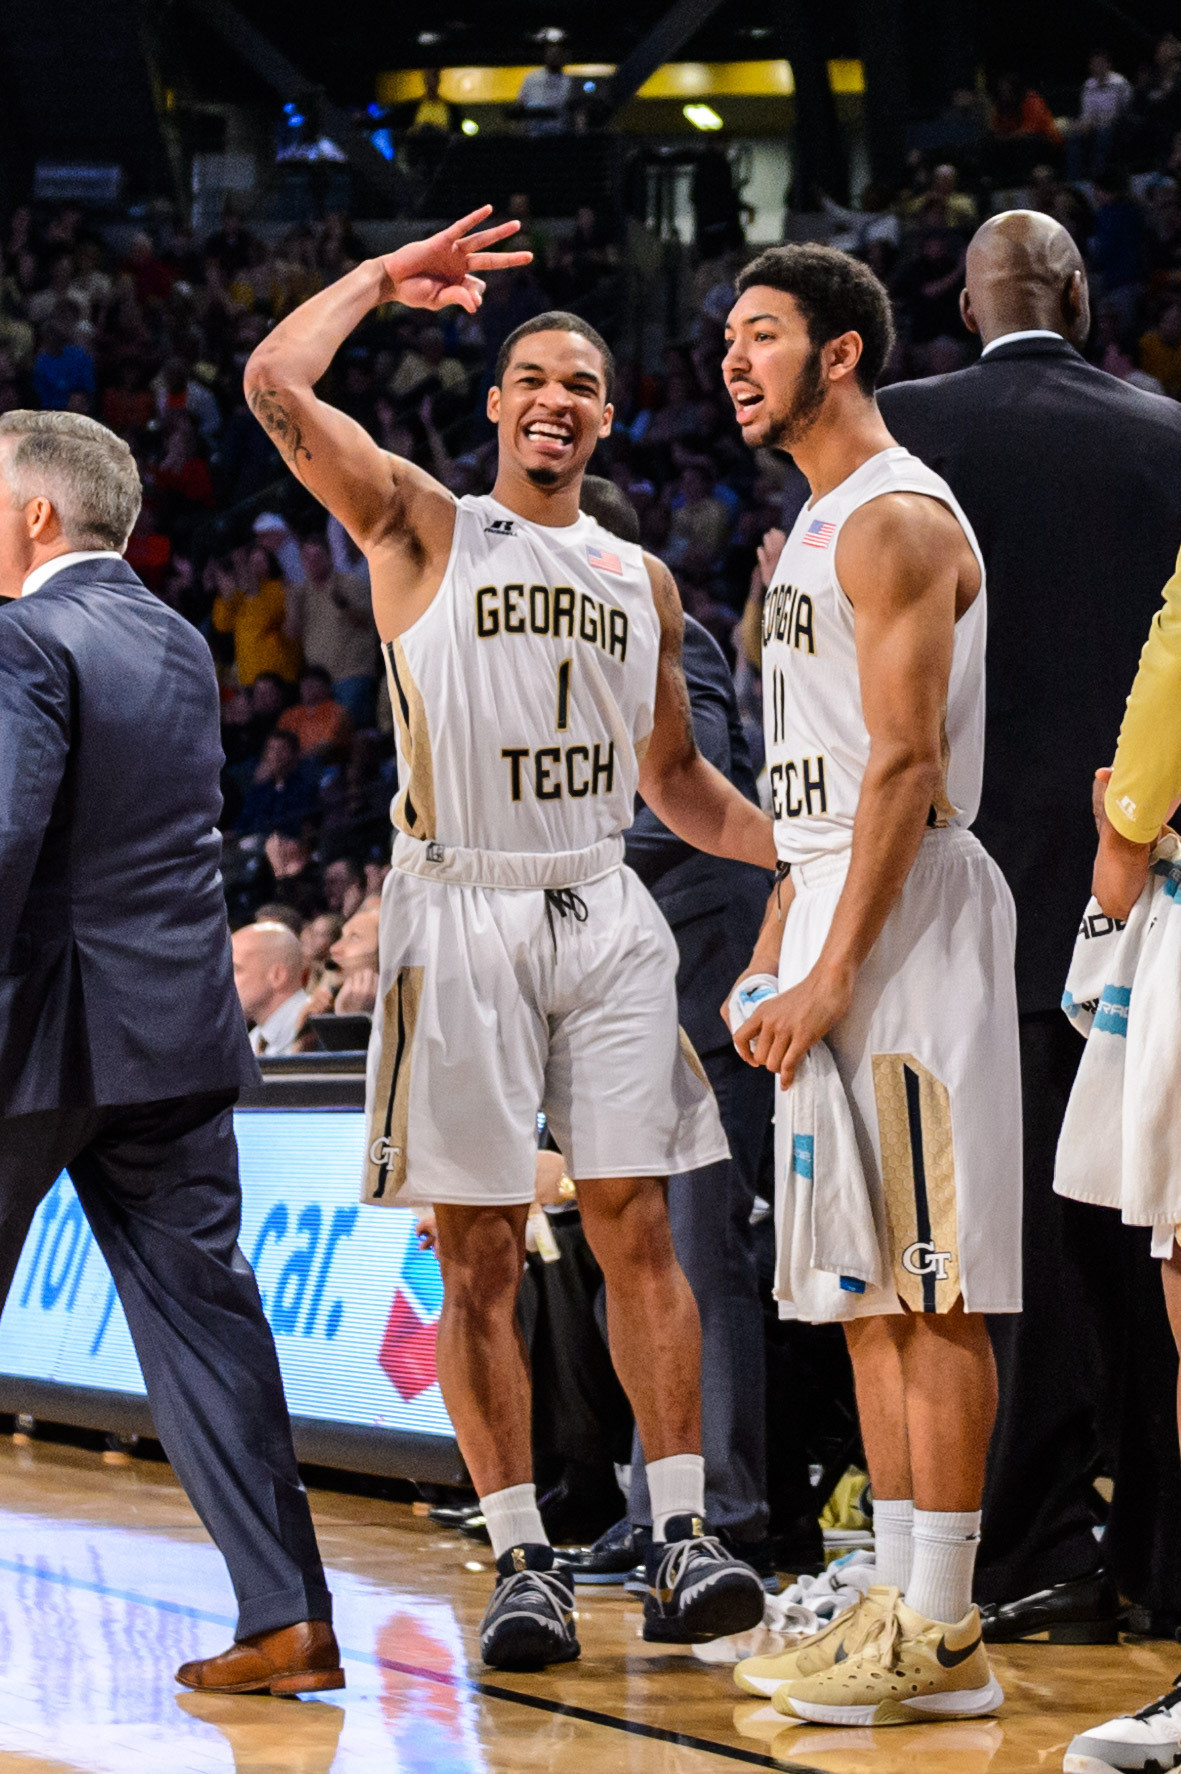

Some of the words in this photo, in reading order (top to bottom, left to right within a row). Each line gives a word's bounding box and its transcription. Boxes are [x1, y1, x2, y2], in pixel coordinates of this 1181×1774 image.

[476, 584, 628, 663] GEORGIA
[556, 658, 572, 732] 1
[773, 665, 785, 745] 11
[501, 741, 614, 801] TECH
[770, 754, 828, 820] ECH
[902, 1240, 951, 1280] GT
